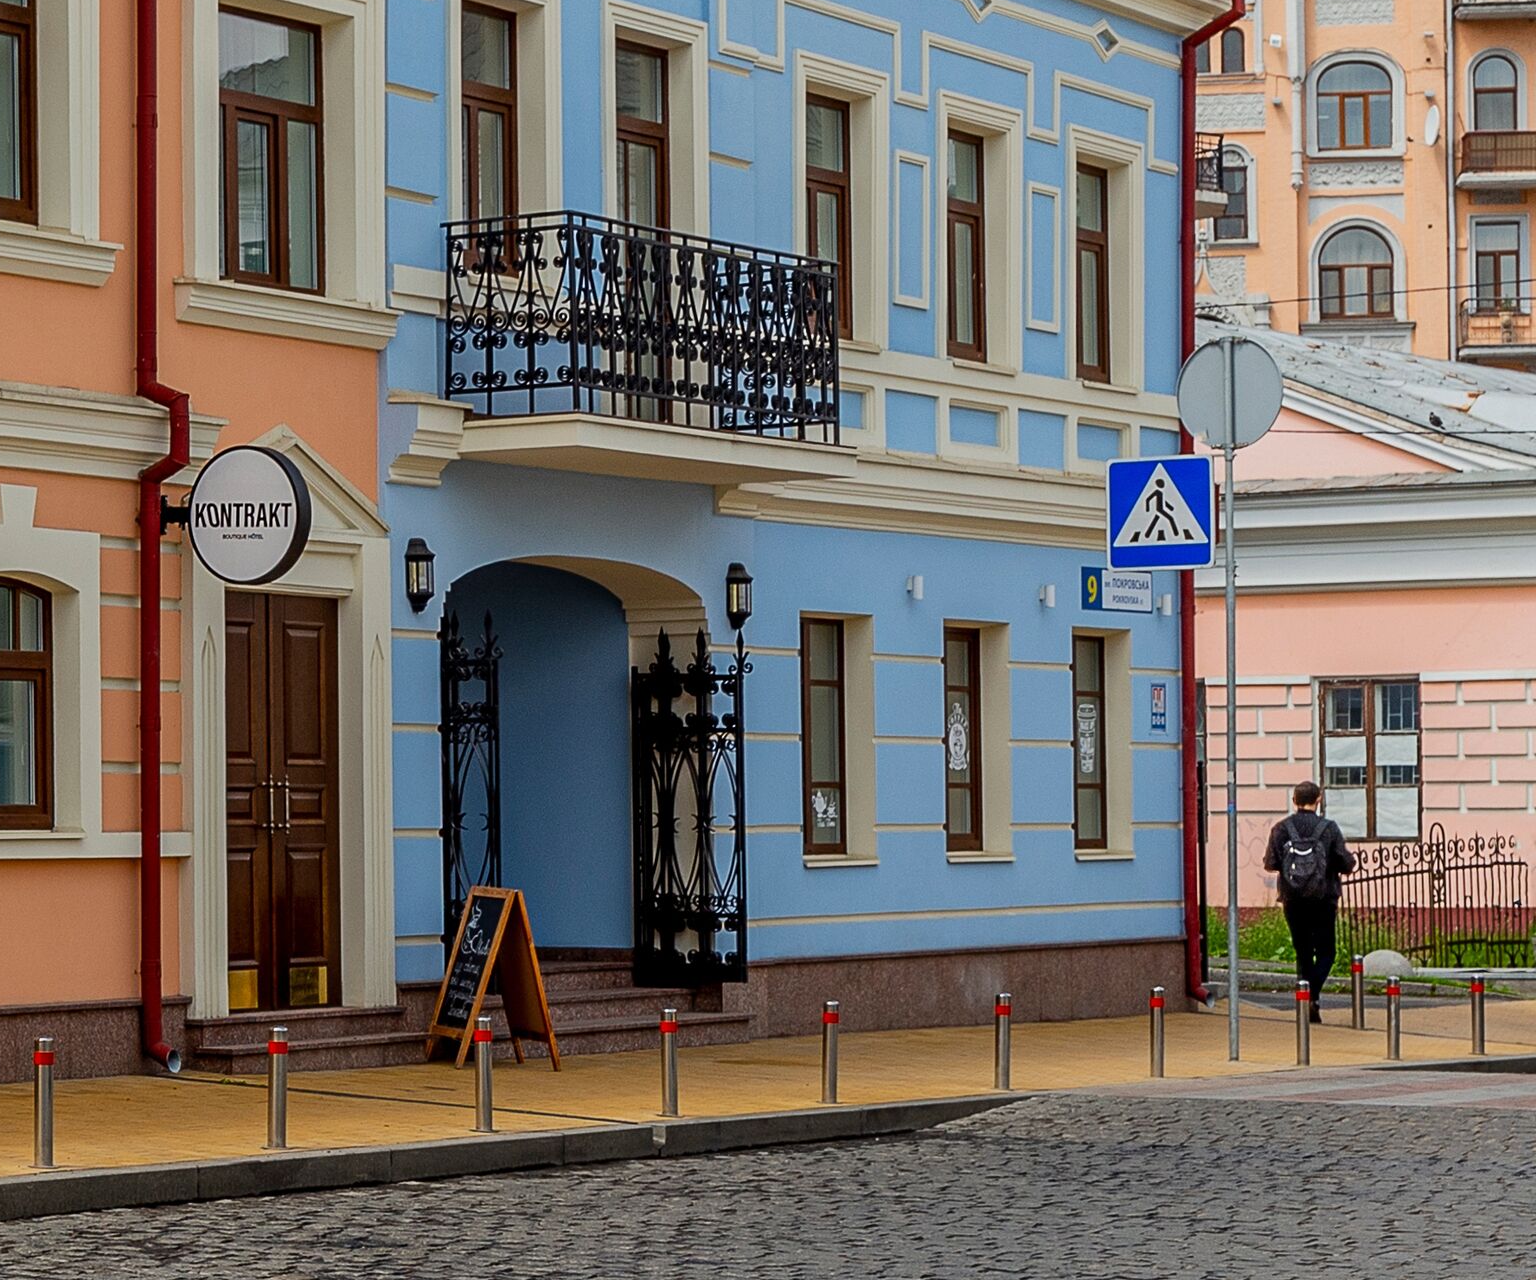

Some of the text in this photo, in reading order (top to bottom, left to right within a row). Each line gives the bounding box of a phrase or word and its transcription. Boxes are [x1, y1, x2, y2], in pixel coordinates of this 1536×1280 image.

[195, 503, 292, 528] KONTRAKT
[1087, 575, 1098, 604] 9
[1112, 578, 1150, 590] ПОКРОВСЬКА
